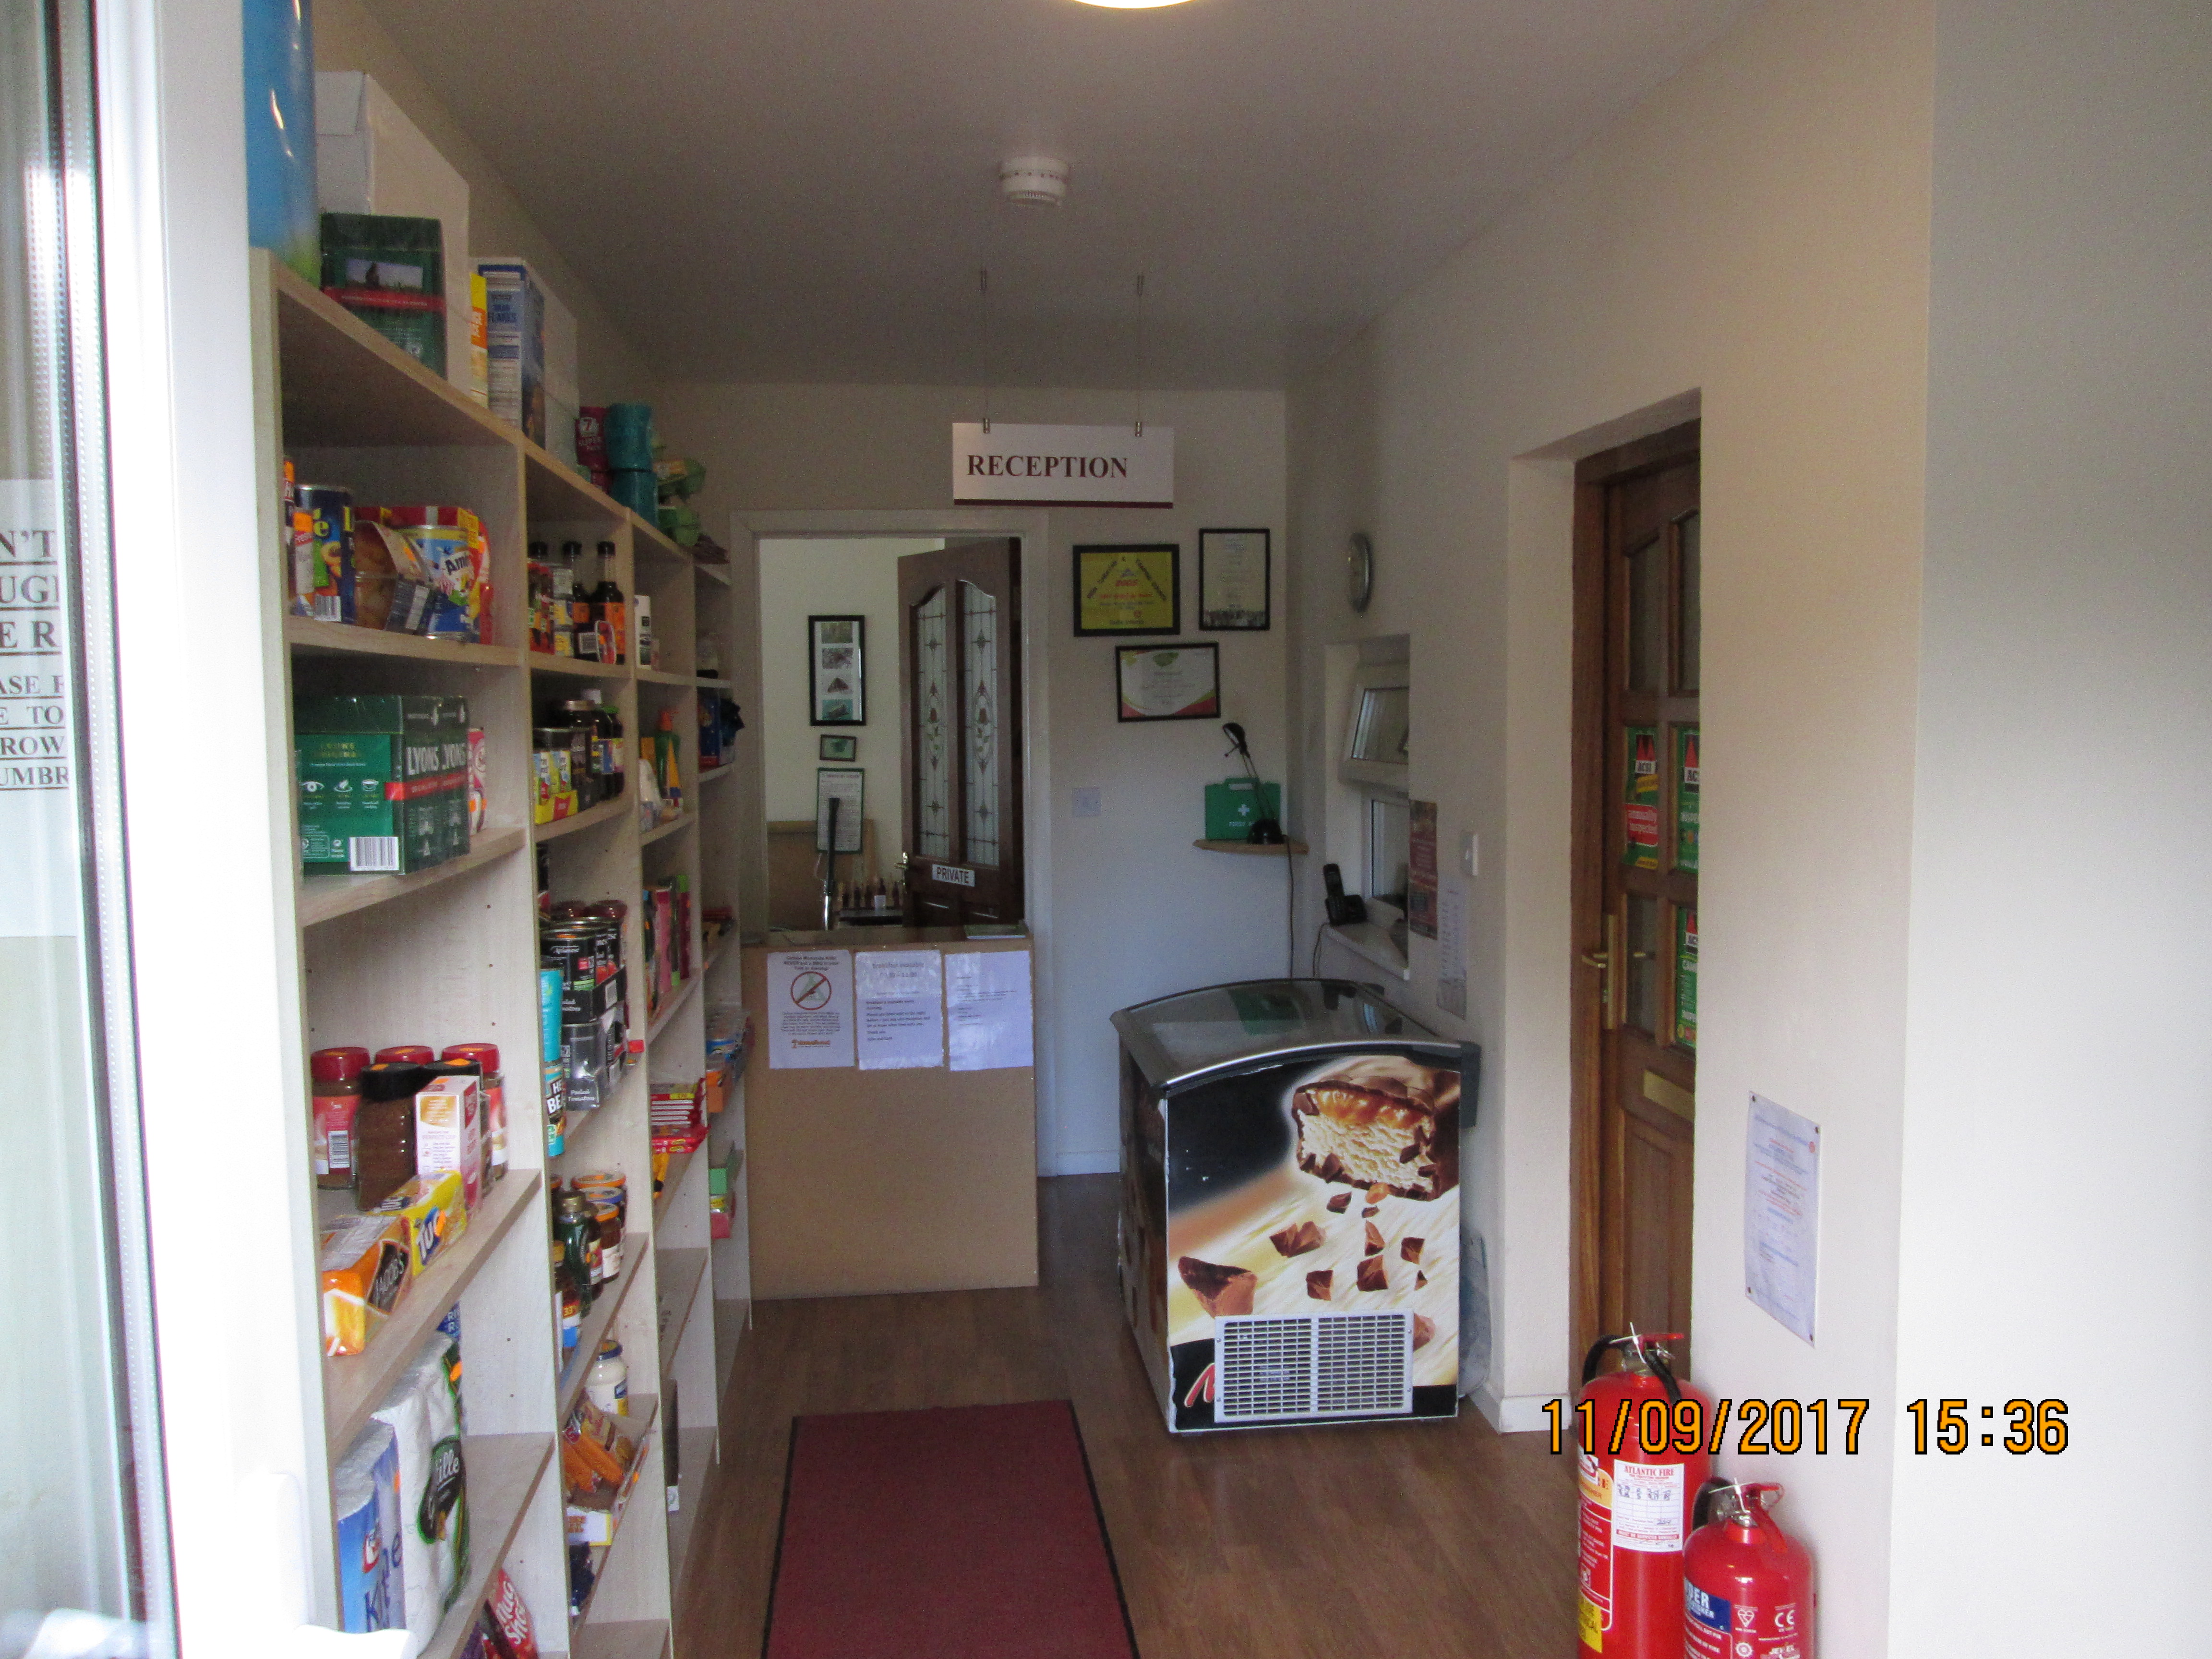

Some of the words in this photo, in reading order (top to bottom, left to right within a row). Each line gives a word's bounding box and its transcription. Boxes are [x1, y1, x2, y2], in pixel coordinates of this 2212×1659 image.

[967, 454, 1129, 479] RECEPTION
[26, 706, 64, 724] TO
[0, 736, 65, 756] ROW
[406, 746, 439, 776] LYONS
[937, 866, 969, 884] PRIVATE
[1624, 1465, 1657, 1476] ATLANTIC
[1659, 1468, 1674, 1477] FIRE
[1775, 1609, 1795, 1627] CE
